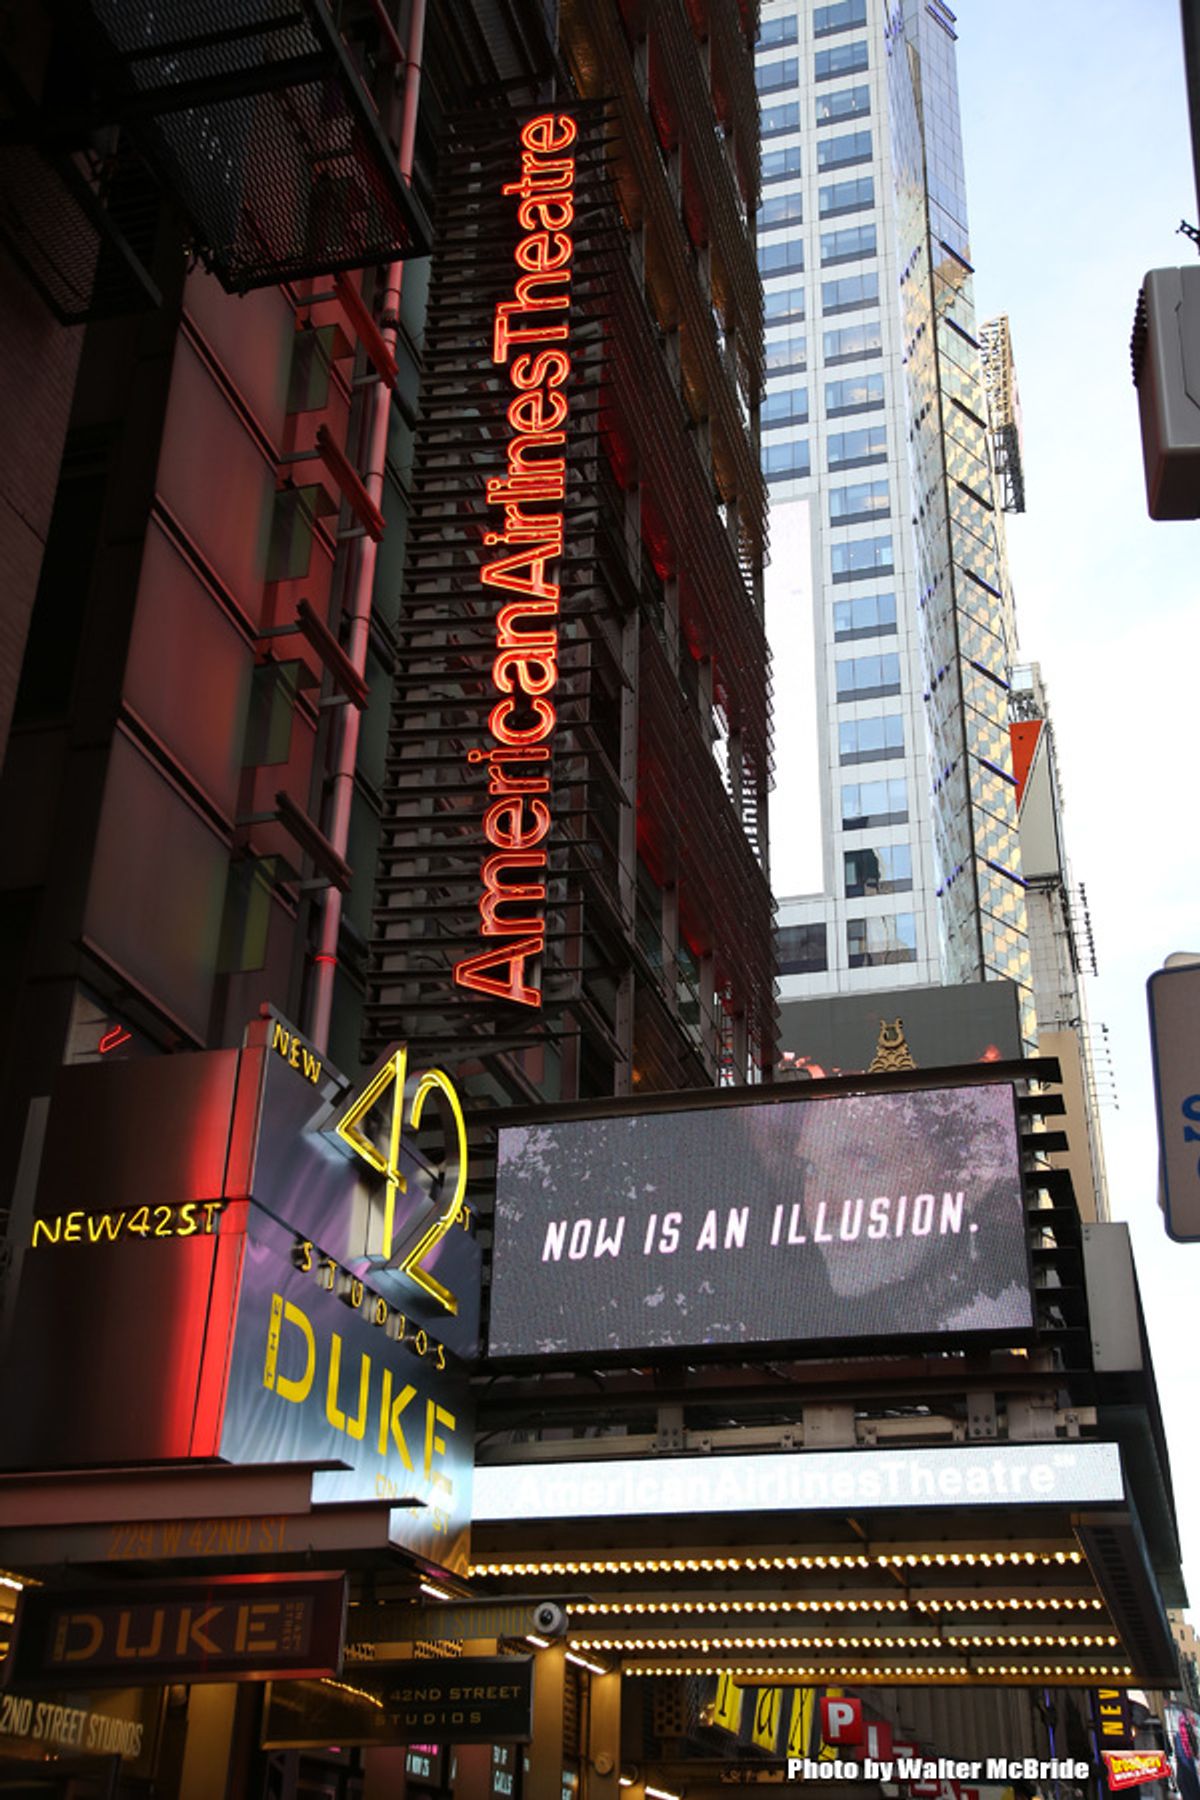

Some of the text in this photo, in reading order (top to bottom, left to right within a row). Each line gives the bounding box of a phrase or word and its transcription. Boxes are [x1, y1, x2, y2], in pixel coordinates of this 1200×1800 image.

[452, 113, 577, 1007] AmericanAirlinesTheatre
[272, 1022, 321, 1085] NEW
[336, 1045, 468, 1316] 42
[542, 1191, 980, 1262] NOW IS AN ILLUSION.
[301, 1241, 446, 1370] STUDIOS
[263, 1292, 456, 1496] DUKE
[107, 1523, 154, 1560] 229
[162, 1519, 185, 1554] W
[188, 1516, 252, 1554] 42ND
[52, 1601, 281, 1663] DUKE
[374, 1711, 483, 1727] STUDIOS
[390, 1687, 442, 1703] 42ND
[448, 1684, 523, 1701] STREET
[31, 1701, 88, 1746] STREET
[86, 1712, 144, 1758] STUDIOS
